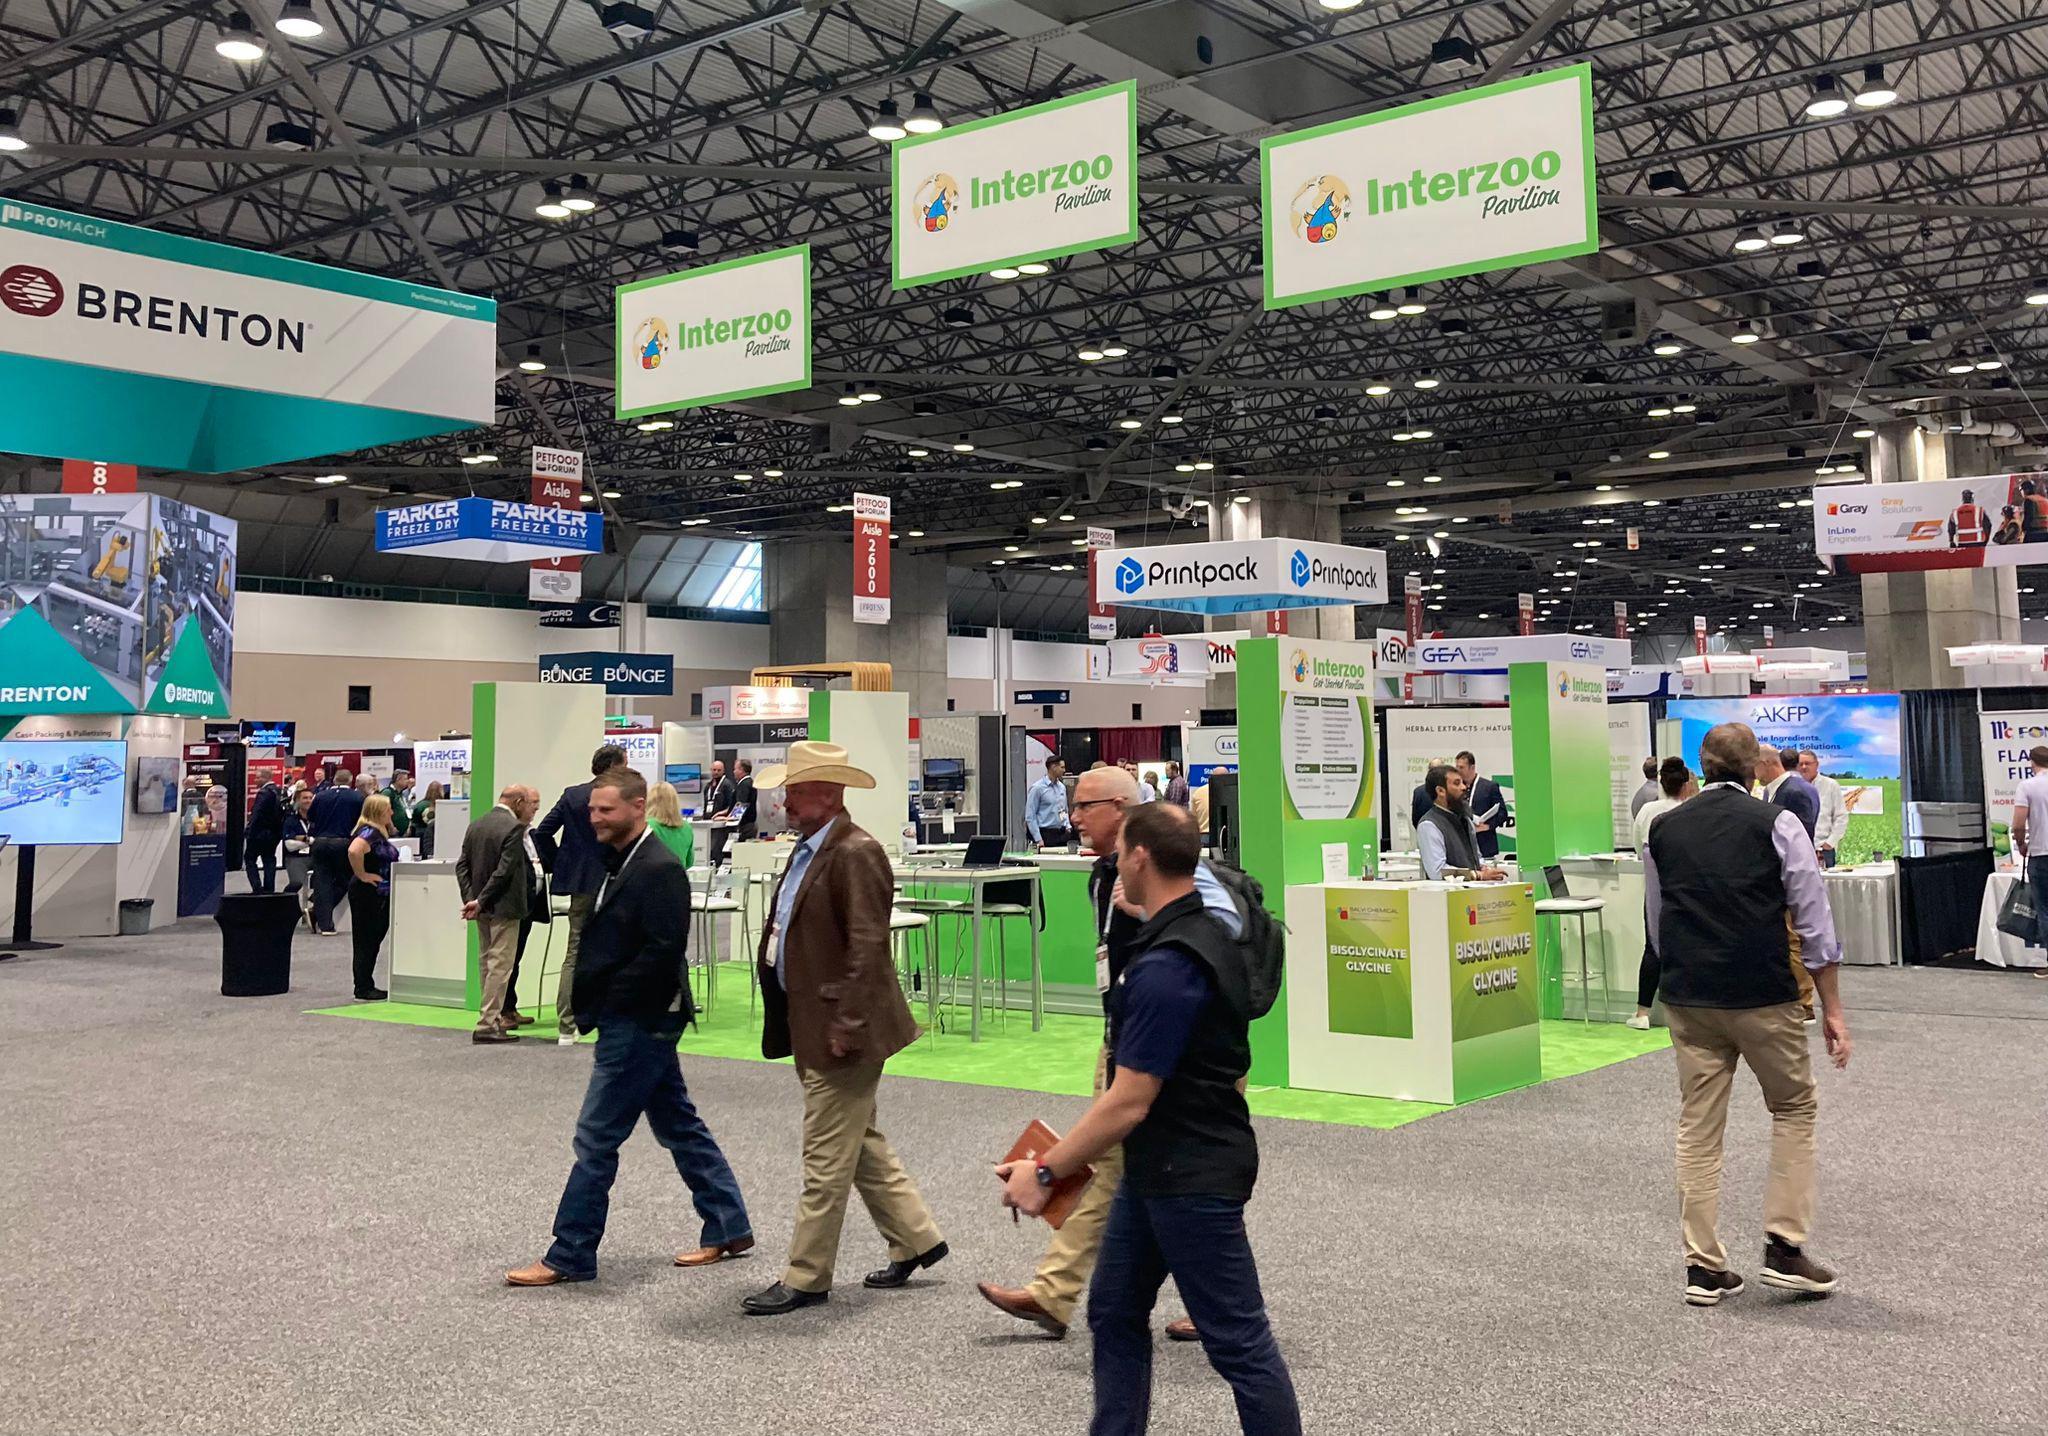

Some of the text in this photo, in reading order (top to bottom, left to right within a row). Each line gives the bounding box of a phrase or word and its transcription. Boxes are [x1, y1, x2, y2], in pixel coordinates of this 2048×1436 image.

[970, 154, 1113, 209] Interzoo
[1367, 150, 1561, 216] Interzoo
[1054, 185, 1112, 213] Pavilion
[1482, 186, 1560, 219] Pavilion
[23, 211, 106, 238] PROMACH
[77, 283, 305, 353] BRENTON
[678, 308, 792, 350] Interzoo
[744, 336, 791, 358] Pavilion
[536, 451, 579, 466] PETFOOD
[547, 463, 576, 474] FORUM
[543, 482, 571, 498] Aisle
[856, 497, 888, 509] PETFOOD
[865, 507, 886, 515] FORUM
[1840, 504, 1868, 514] Gray
[1881, 505, 1923, 514] Solutions
[387, 501, 459, 526] PARKER
[492, 500, 588, 528] PARKER
[387, 518, 460, 538] FREEZE DRY
[491, 518, 588, 538] FREEZE DRY
[861, 522, 883, 536] Aisle
[1827, 527, 1857, 535] InLine
[1828, 535, 1872, 544] Engineers
[868, 539, 876, 593] 2600
[1149, 556, 1258, 588] Printpack
[1312, 558, 1378, 590] Printpack
[1381, 641, 1407, 664] KEM
[1422, 647, 1467, 662] GEA
[1570, 642, 1592, 658] GEA
[541, 667, 593, 683] BUNGE
[604, 667, 666, 683] BUNGE
[1313, 657, 1365, 678] Interzoo
[1572, 676, 1603, 693] Interzoo
[0, 686, 88, 703] RENTON
[176, 686, 214, 705] BRENTON
[1757, 706, 1810, 722] AKFP
[15, 731, 34, 739] Case
[777, 728, 809, 738] RELIABL
[1405, 725, 1435, 733] HERBAL
[1486, 724, 1512, 732] NATUR
[419, 749, 467, 761] PARKER
[1998, 749, 2033, 763] FLA
[2008, 766, 2035, 780] FIR
[1330, 945, 1408, 959] BISGLYCINATE
[1455, 932, 1532, 963] BISGLYCINATE
[1346, 961, 1392, 974] GLYCINE
[1473, 966, 1519, 993] GLYCINE
